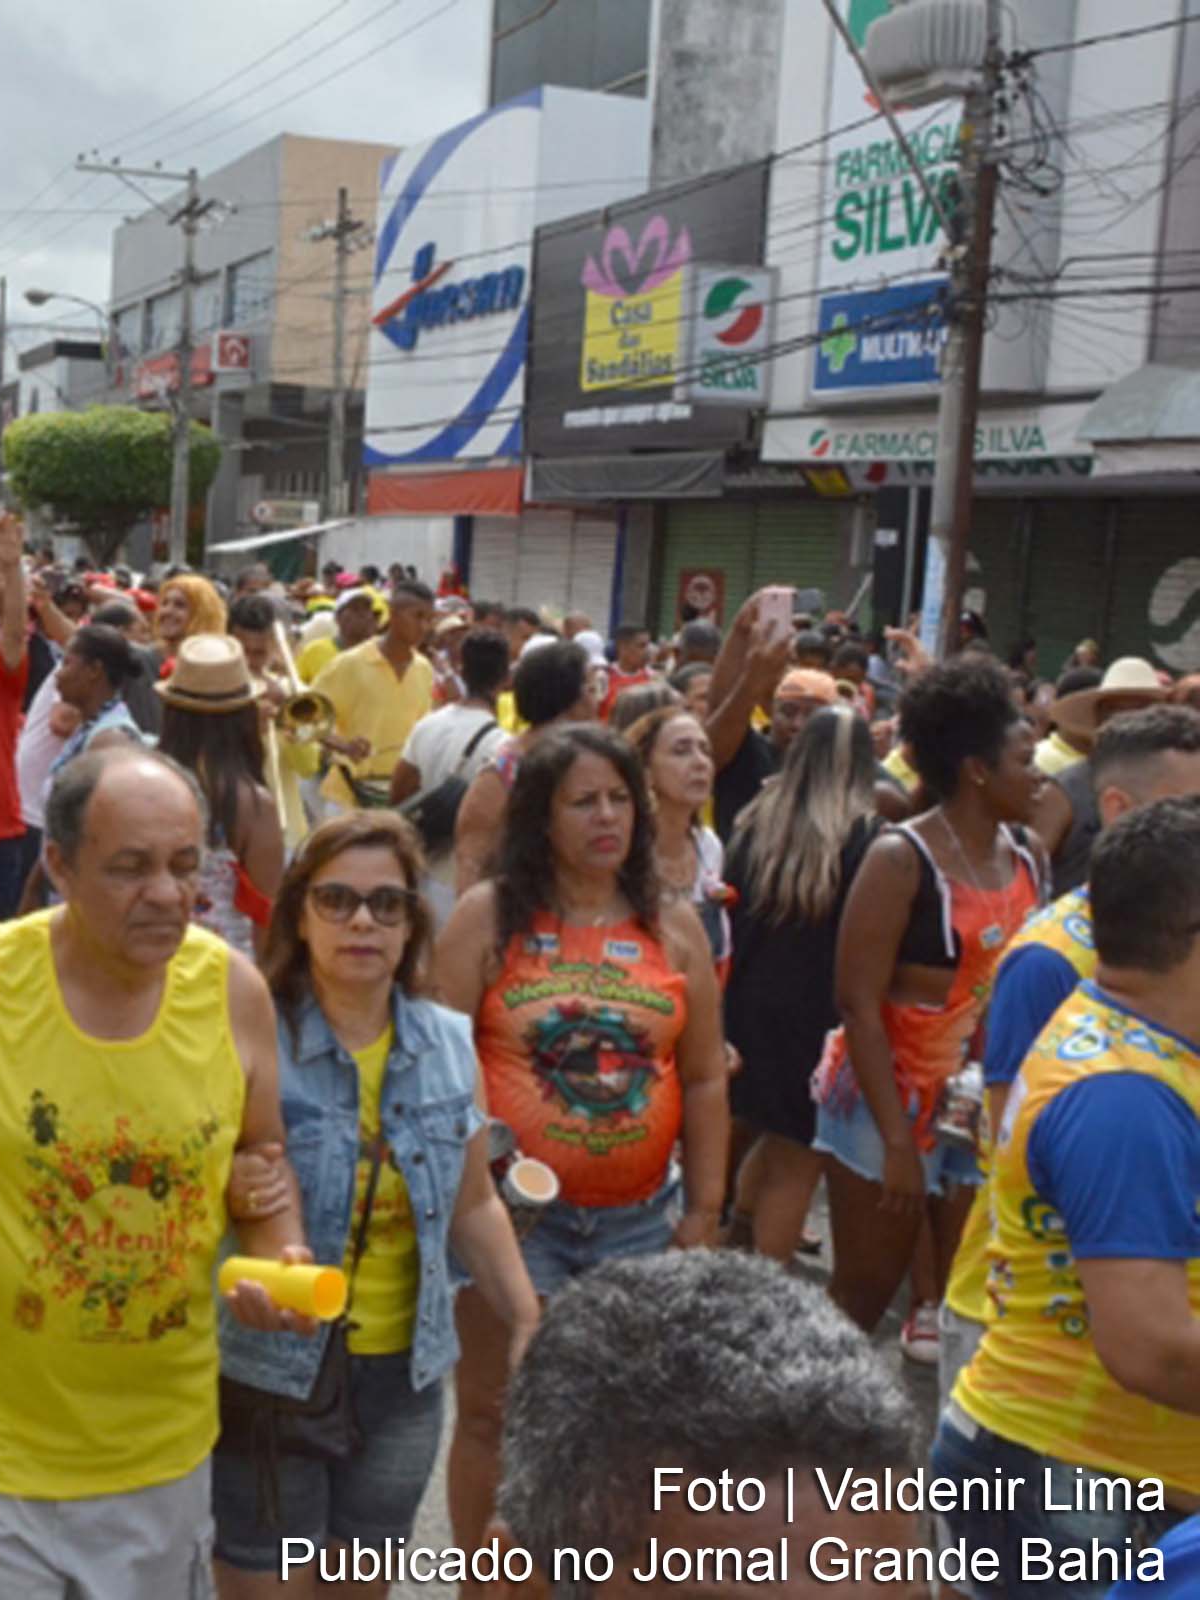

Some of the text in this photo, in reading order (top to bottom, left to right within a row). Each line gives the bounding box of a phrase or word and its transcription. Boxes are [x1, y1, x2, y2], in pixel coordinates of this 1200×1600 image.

[611, 301, 652, 326] Casa
[834, 426, 1047, 456] FARMACI SILVA
